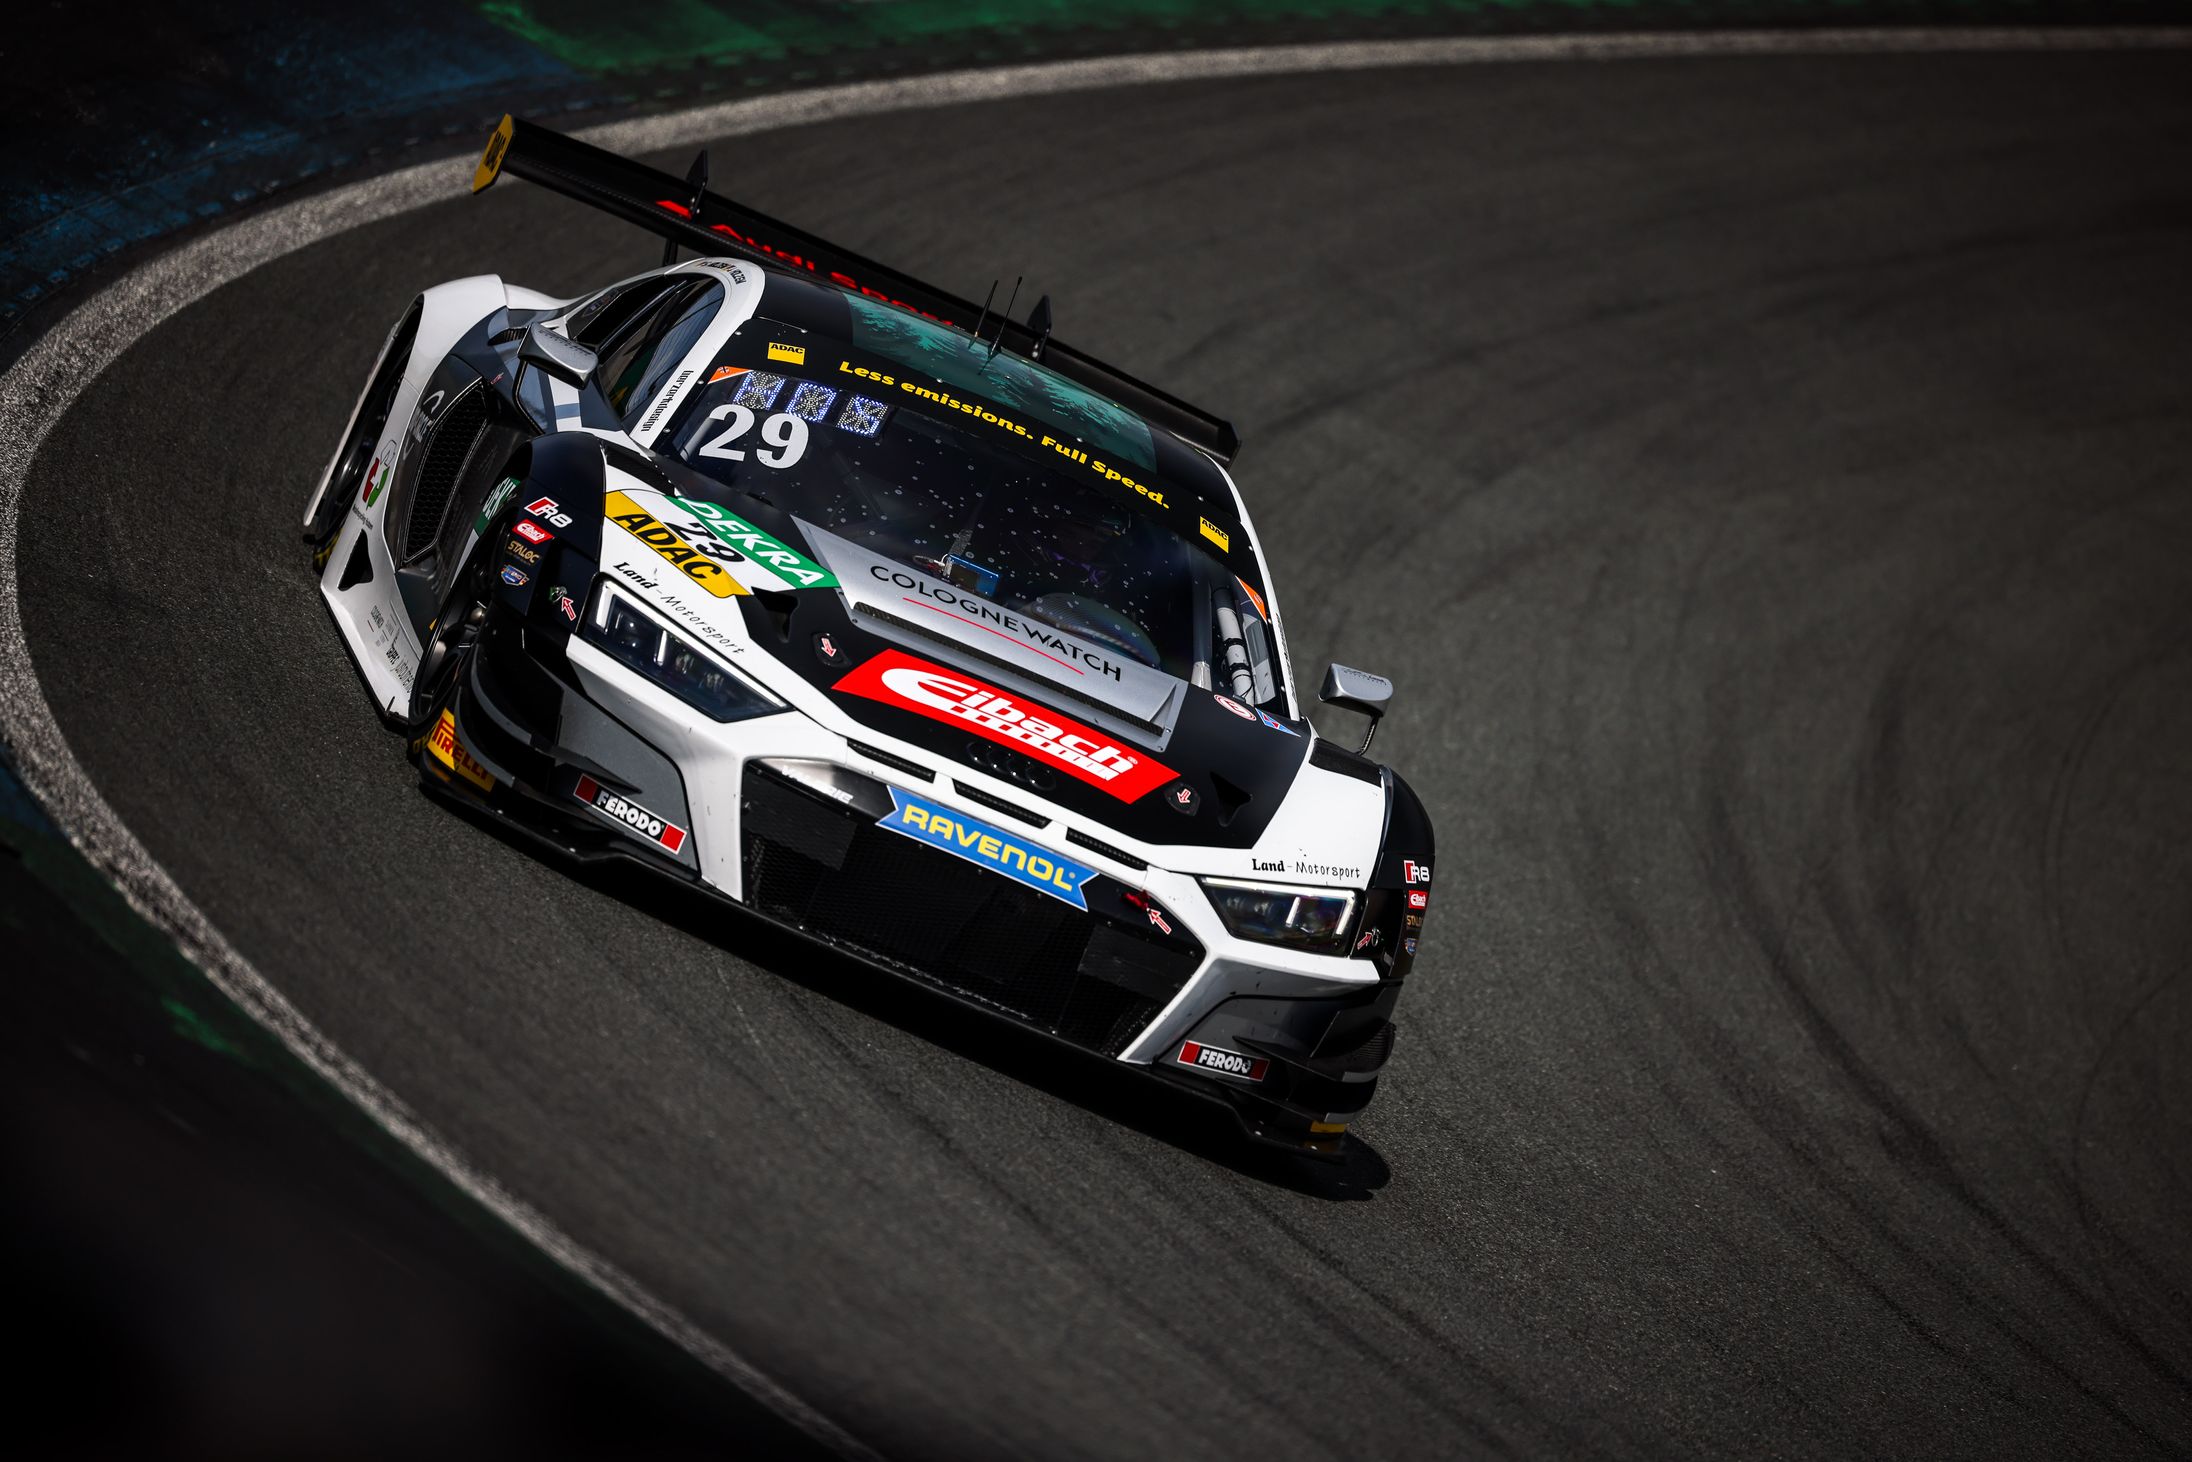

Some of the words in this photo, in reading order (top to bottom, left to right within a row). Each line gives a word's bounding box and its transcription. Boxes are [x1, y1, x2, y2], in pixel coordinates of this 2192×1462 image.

[771, 343, 804, 354] ADAC
[698, 403, 809, 469] 29
[839, 361, 895, 386] Less
[900, 382, 1034, 440] emissions.
[1041, 435, 1088, 464] Full
[1091, 460, 1170, 509] Speed.
[530, 500, 573, 528] R8
[664, 521, 746, 563] 29
[677, 497, 825, 586] DEKRA
[1201, 519, 1228, 541] ADAC
[507, 540, 540, 563] STALOC
[613, 513, 722, 580] ADAC
[613, 561, 658, 589] Land
[661, 595, 745, 654] Motorsport
[870, 565, 1121, 682] COLOGNEWATCH
[881, 668, 1135, 777] Eibach
[596, 791, 662, 837] FERODO
[902, 804, 1073, 892] RAVENOL
[1251, 858, 1285, 872] Land
[1296, 861, 1360, 880] Motorsport
[1408, 862, 1430, 883] R8
